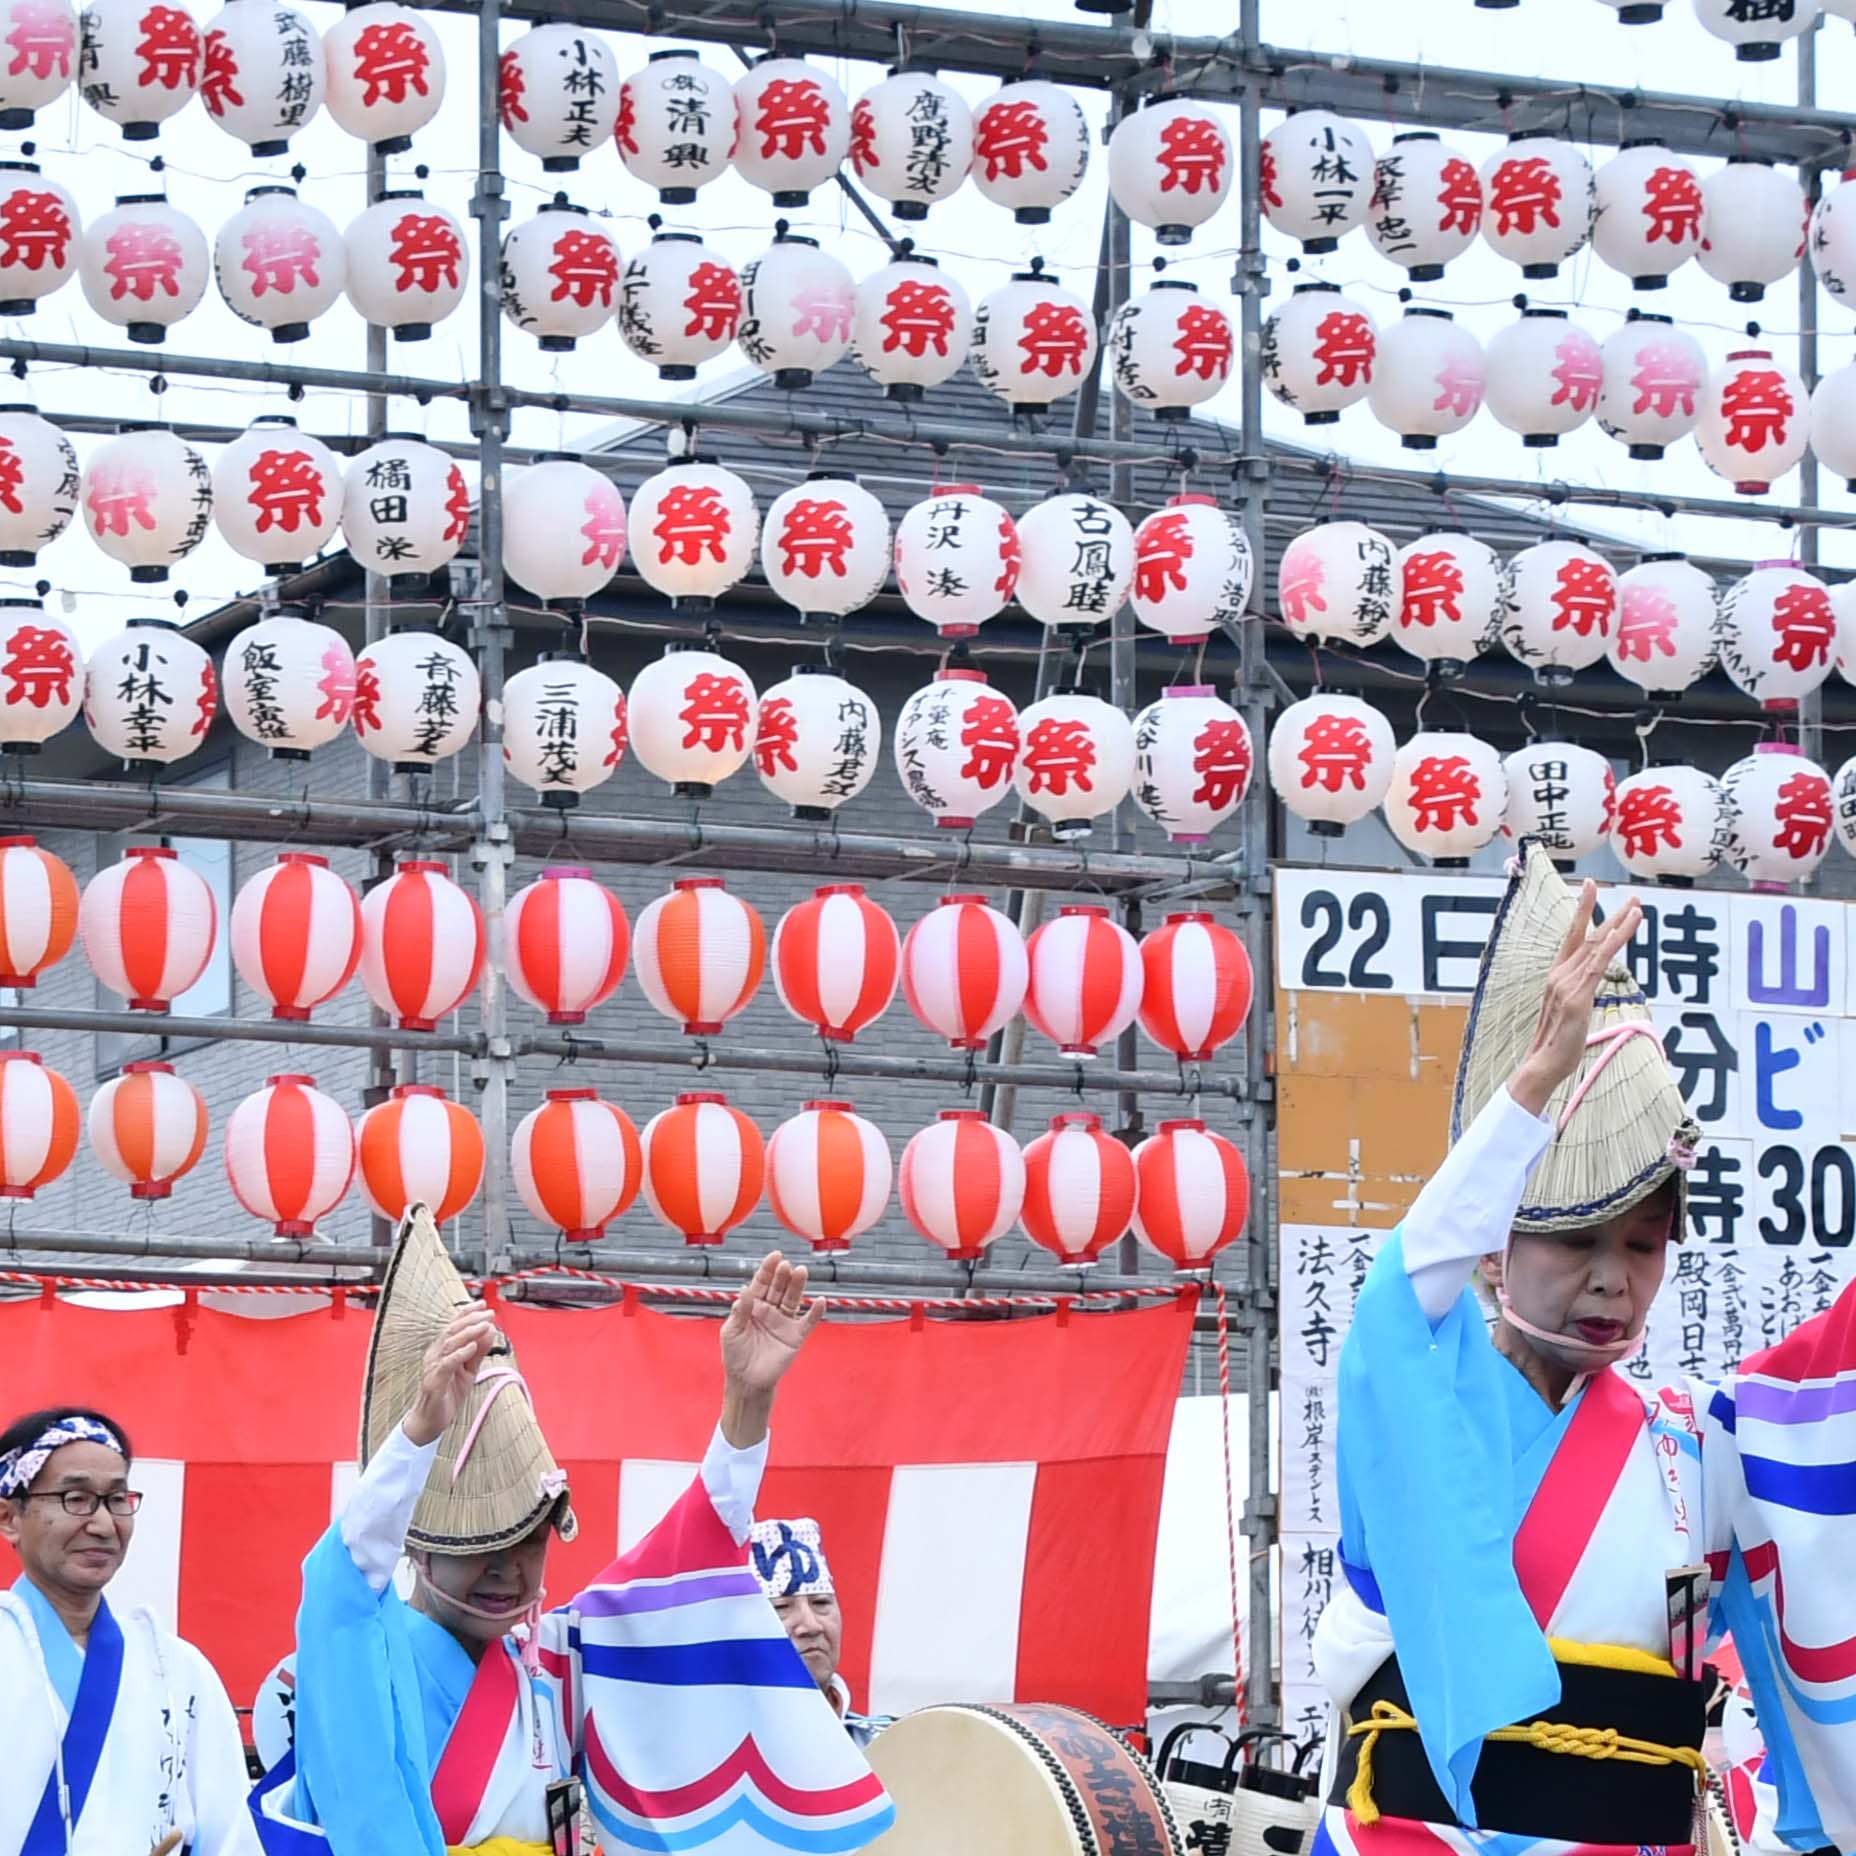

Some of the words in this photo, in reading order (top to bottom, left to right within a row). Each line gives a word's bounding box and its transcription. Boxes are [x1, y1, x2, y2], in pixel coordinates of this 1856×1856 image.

[136, 5, 199, 90] 祭
[353, 22, 429, 108] 祭
[559, 39, 605, 147] 小林正夫
[754, 80, 831, 160] 祭
[972, 101, 1048, 182] 祭
[1157, 117, 1225, 195] 祭
[1309, 126, 1359, 226] 小林一平
[1490, 158, 1562, 237] 祭
[1642, 167, 1703, 244] 祭
[102, 222, 184, 302] 祭
[389, 214, 461, 293] 祭
[549, 230, 619, 308] 祭
[684, 262, 742, 341] 祭
[880, 280, 955, 357] 祭
[1018, 303, 1088, 378] 祭
[1174, 305, 1231, 380] 祭
[1314, 312, 1376, 388] 祭
[1720, 370, 1793, 454] 祭
[248, 450, 325, 533] 祭
[653, 485, 731, 566] 祭
[778, 499, 854, 579] 祭
[1131, 514, 1193, 604] 祭
[1398, 552, 1464, 629] 祭
[1552, 559, 1616, 637] 祭
[1773, 585, 1836, 671] 祭
[1, 626, 75, 709] 祭
[679, 673, 750, 753] 祭
[960, 696, 1018, 790] 祭
[1023, 718, 1097, 796] 祭
[1192, 720, 1252, 811] 祭
[1298, 714, 1372, 793] 祭
[1407, 756, 1482, 833] 祭
[1616, 785, 1682, 858] 祭
[1772, 774, 1833, 859] 祭
[1297, 1235, 1337, 1367] 法久寺
